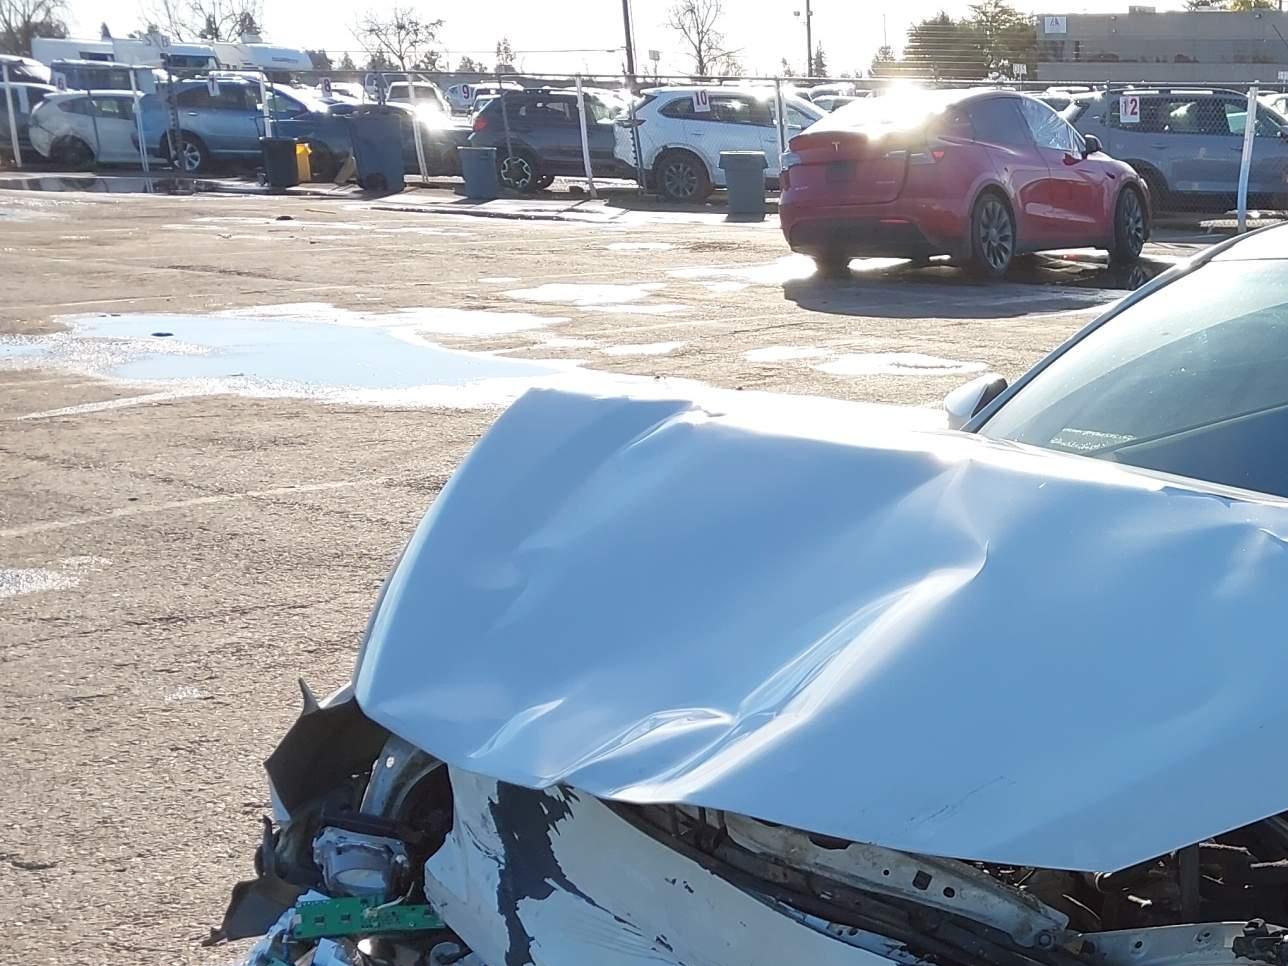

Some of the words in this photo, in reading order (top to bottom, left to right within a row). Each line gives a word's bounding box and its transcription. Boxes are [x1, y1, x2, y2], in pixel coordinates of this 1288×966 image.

[461, 84, 470, 100] 9
[694, 91, 708, 106] 10
[1121, 99, 1139, 116] 12
